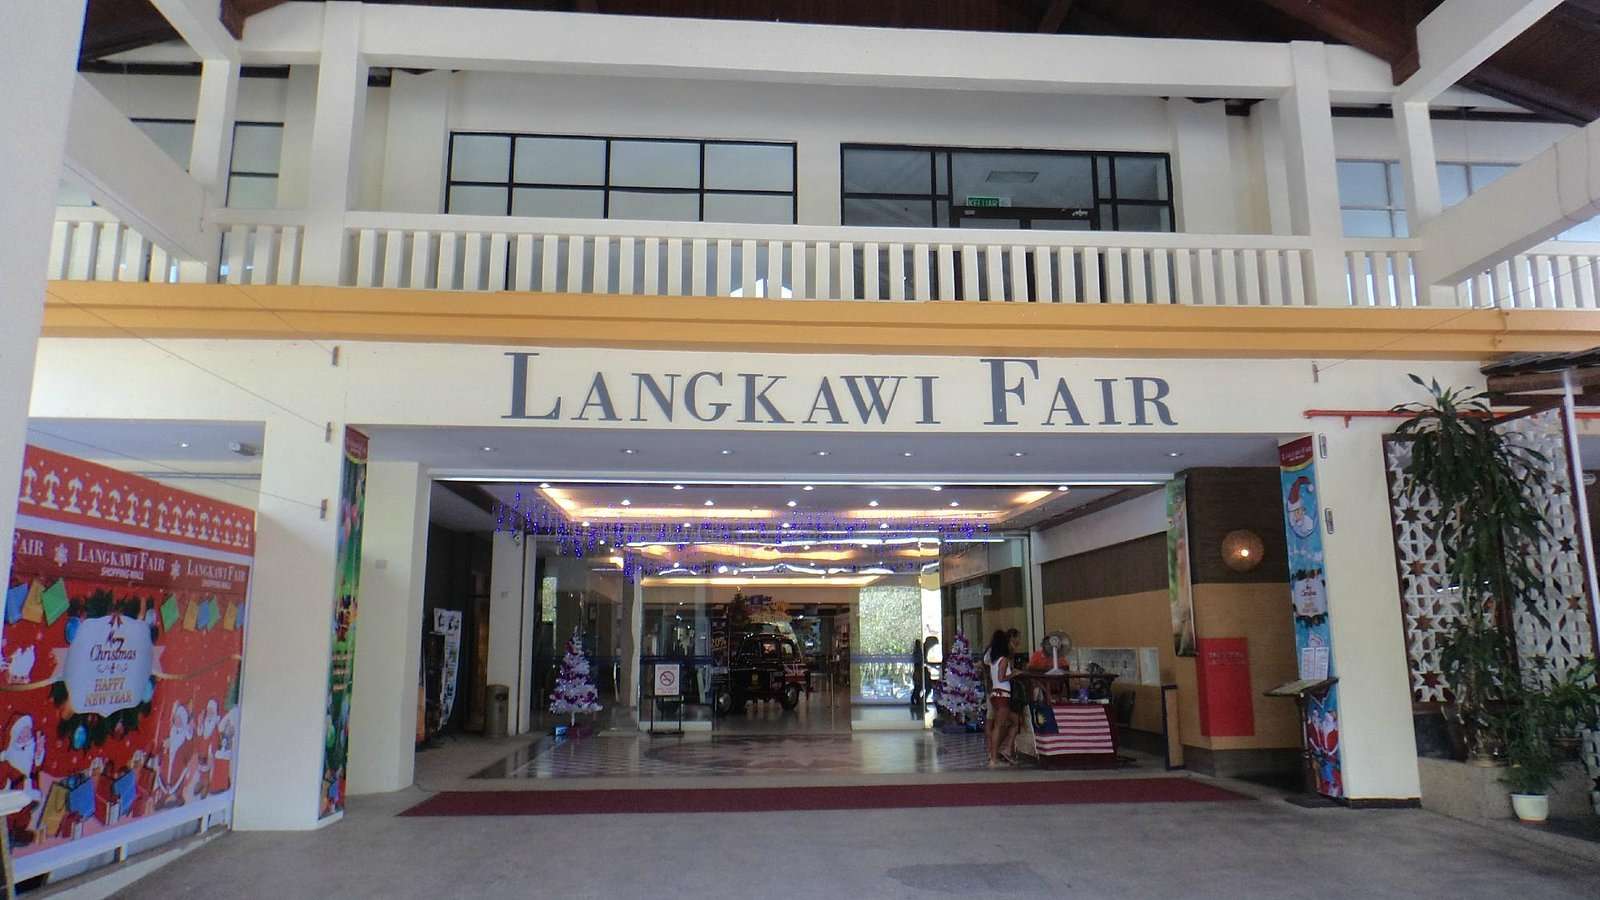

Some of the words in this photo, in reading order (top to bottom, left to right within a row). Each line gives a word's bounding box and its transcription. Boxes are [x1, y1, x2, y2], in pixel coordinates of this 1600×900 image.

[968, 199, 999, 208] KELUAR
[500, 351, 941, 425] LANGKAWI
[979, 358, 1179, 426] FAIR
[78, 542, 138, 569] LANGKAWI
[139, 551, 165, 571] FAIR
[90, 643, 137, 662] Christmas
[95, 676, 125, 692] HAPPY
